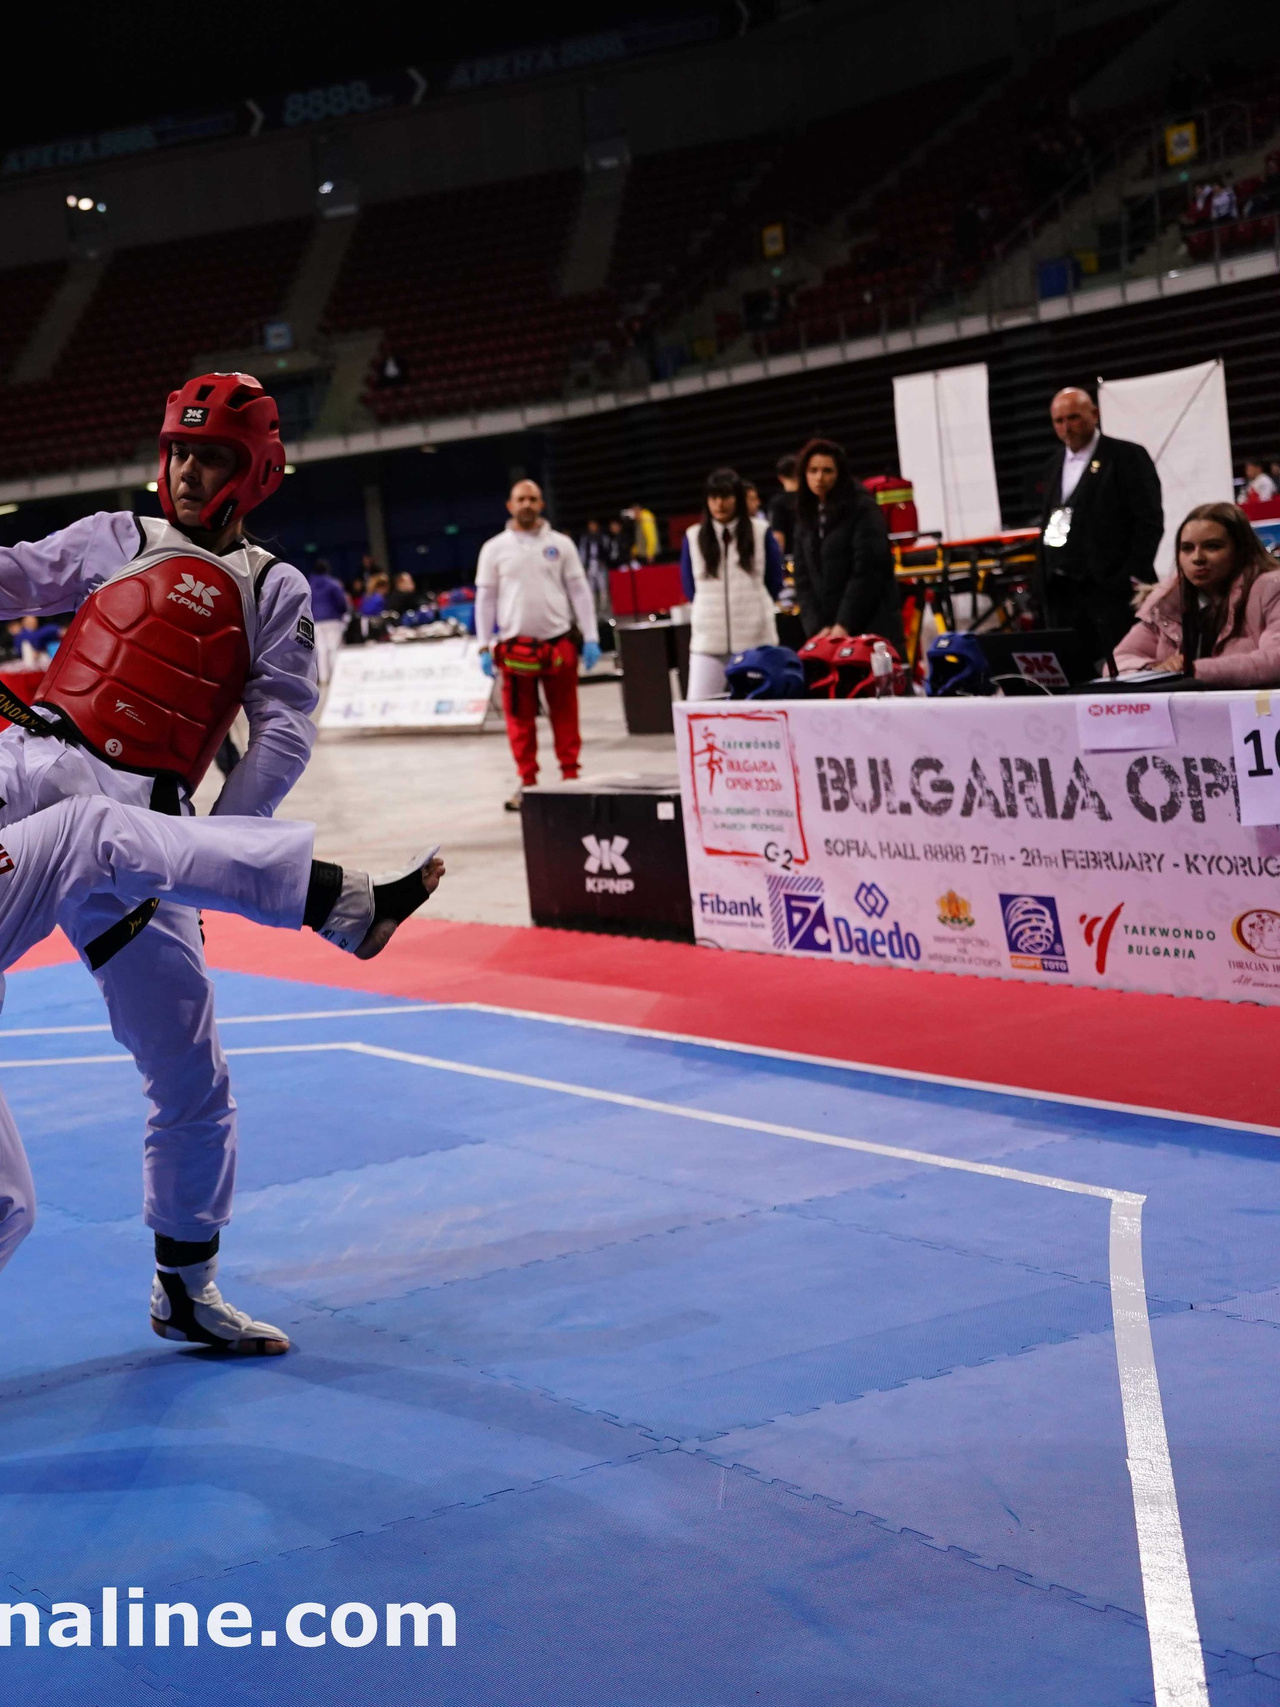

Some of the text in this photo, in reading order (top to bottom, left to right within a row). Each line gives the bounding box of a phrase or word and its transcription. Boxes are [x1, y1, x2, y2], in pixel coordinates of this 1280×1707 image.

[284, 80, 372, 126] 8888
[166, 591, 212, 618] KPNP
[294, 634, 315, 651] KWON
[1105, 703, 1151, 716] KPNP
[108, 741, 119, 754] 3
[1243, 729, 1280, 777] 1
[814, 756, 1113, 822] BULGARIA
[763, 841, 794, 871] G2
[923, 843, 967, 864] 8888
[1061, 848, 1166, 873] FEBRUARY
[585, 876, 635, 895] KPNP
[699, 892, 764, 918] Fibank
[833, 916, 921, 962] Daedo
[1123, 924, 1216, 941] TAEKWONDO
[1127, 944, 1196, 960] BULGARIA
